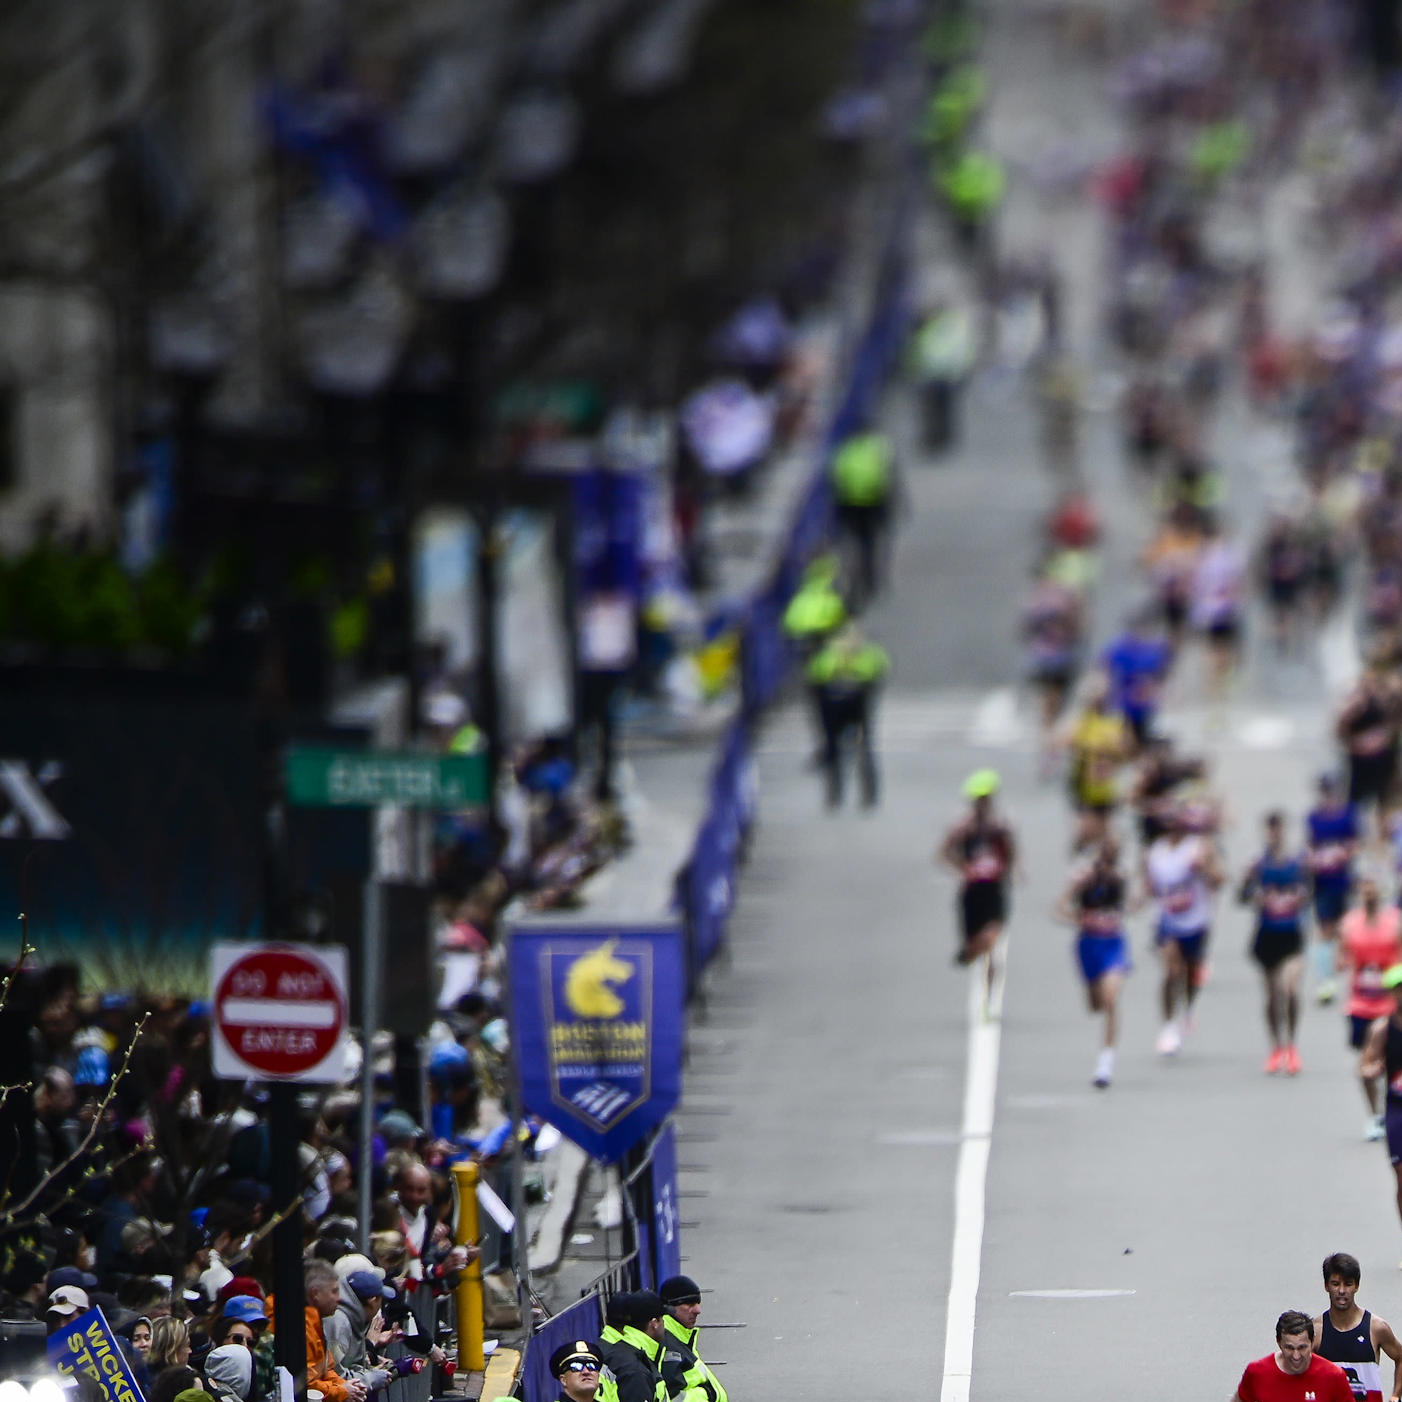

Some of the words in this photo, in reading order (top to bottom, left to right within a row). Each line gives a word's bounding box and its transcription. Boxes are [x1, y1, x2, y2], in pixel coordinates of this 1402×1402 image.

[231, 969, 267, 995] DO
[277, 970, 324, 997] NOT
[241, 1029, 317, 1055] ENTER
